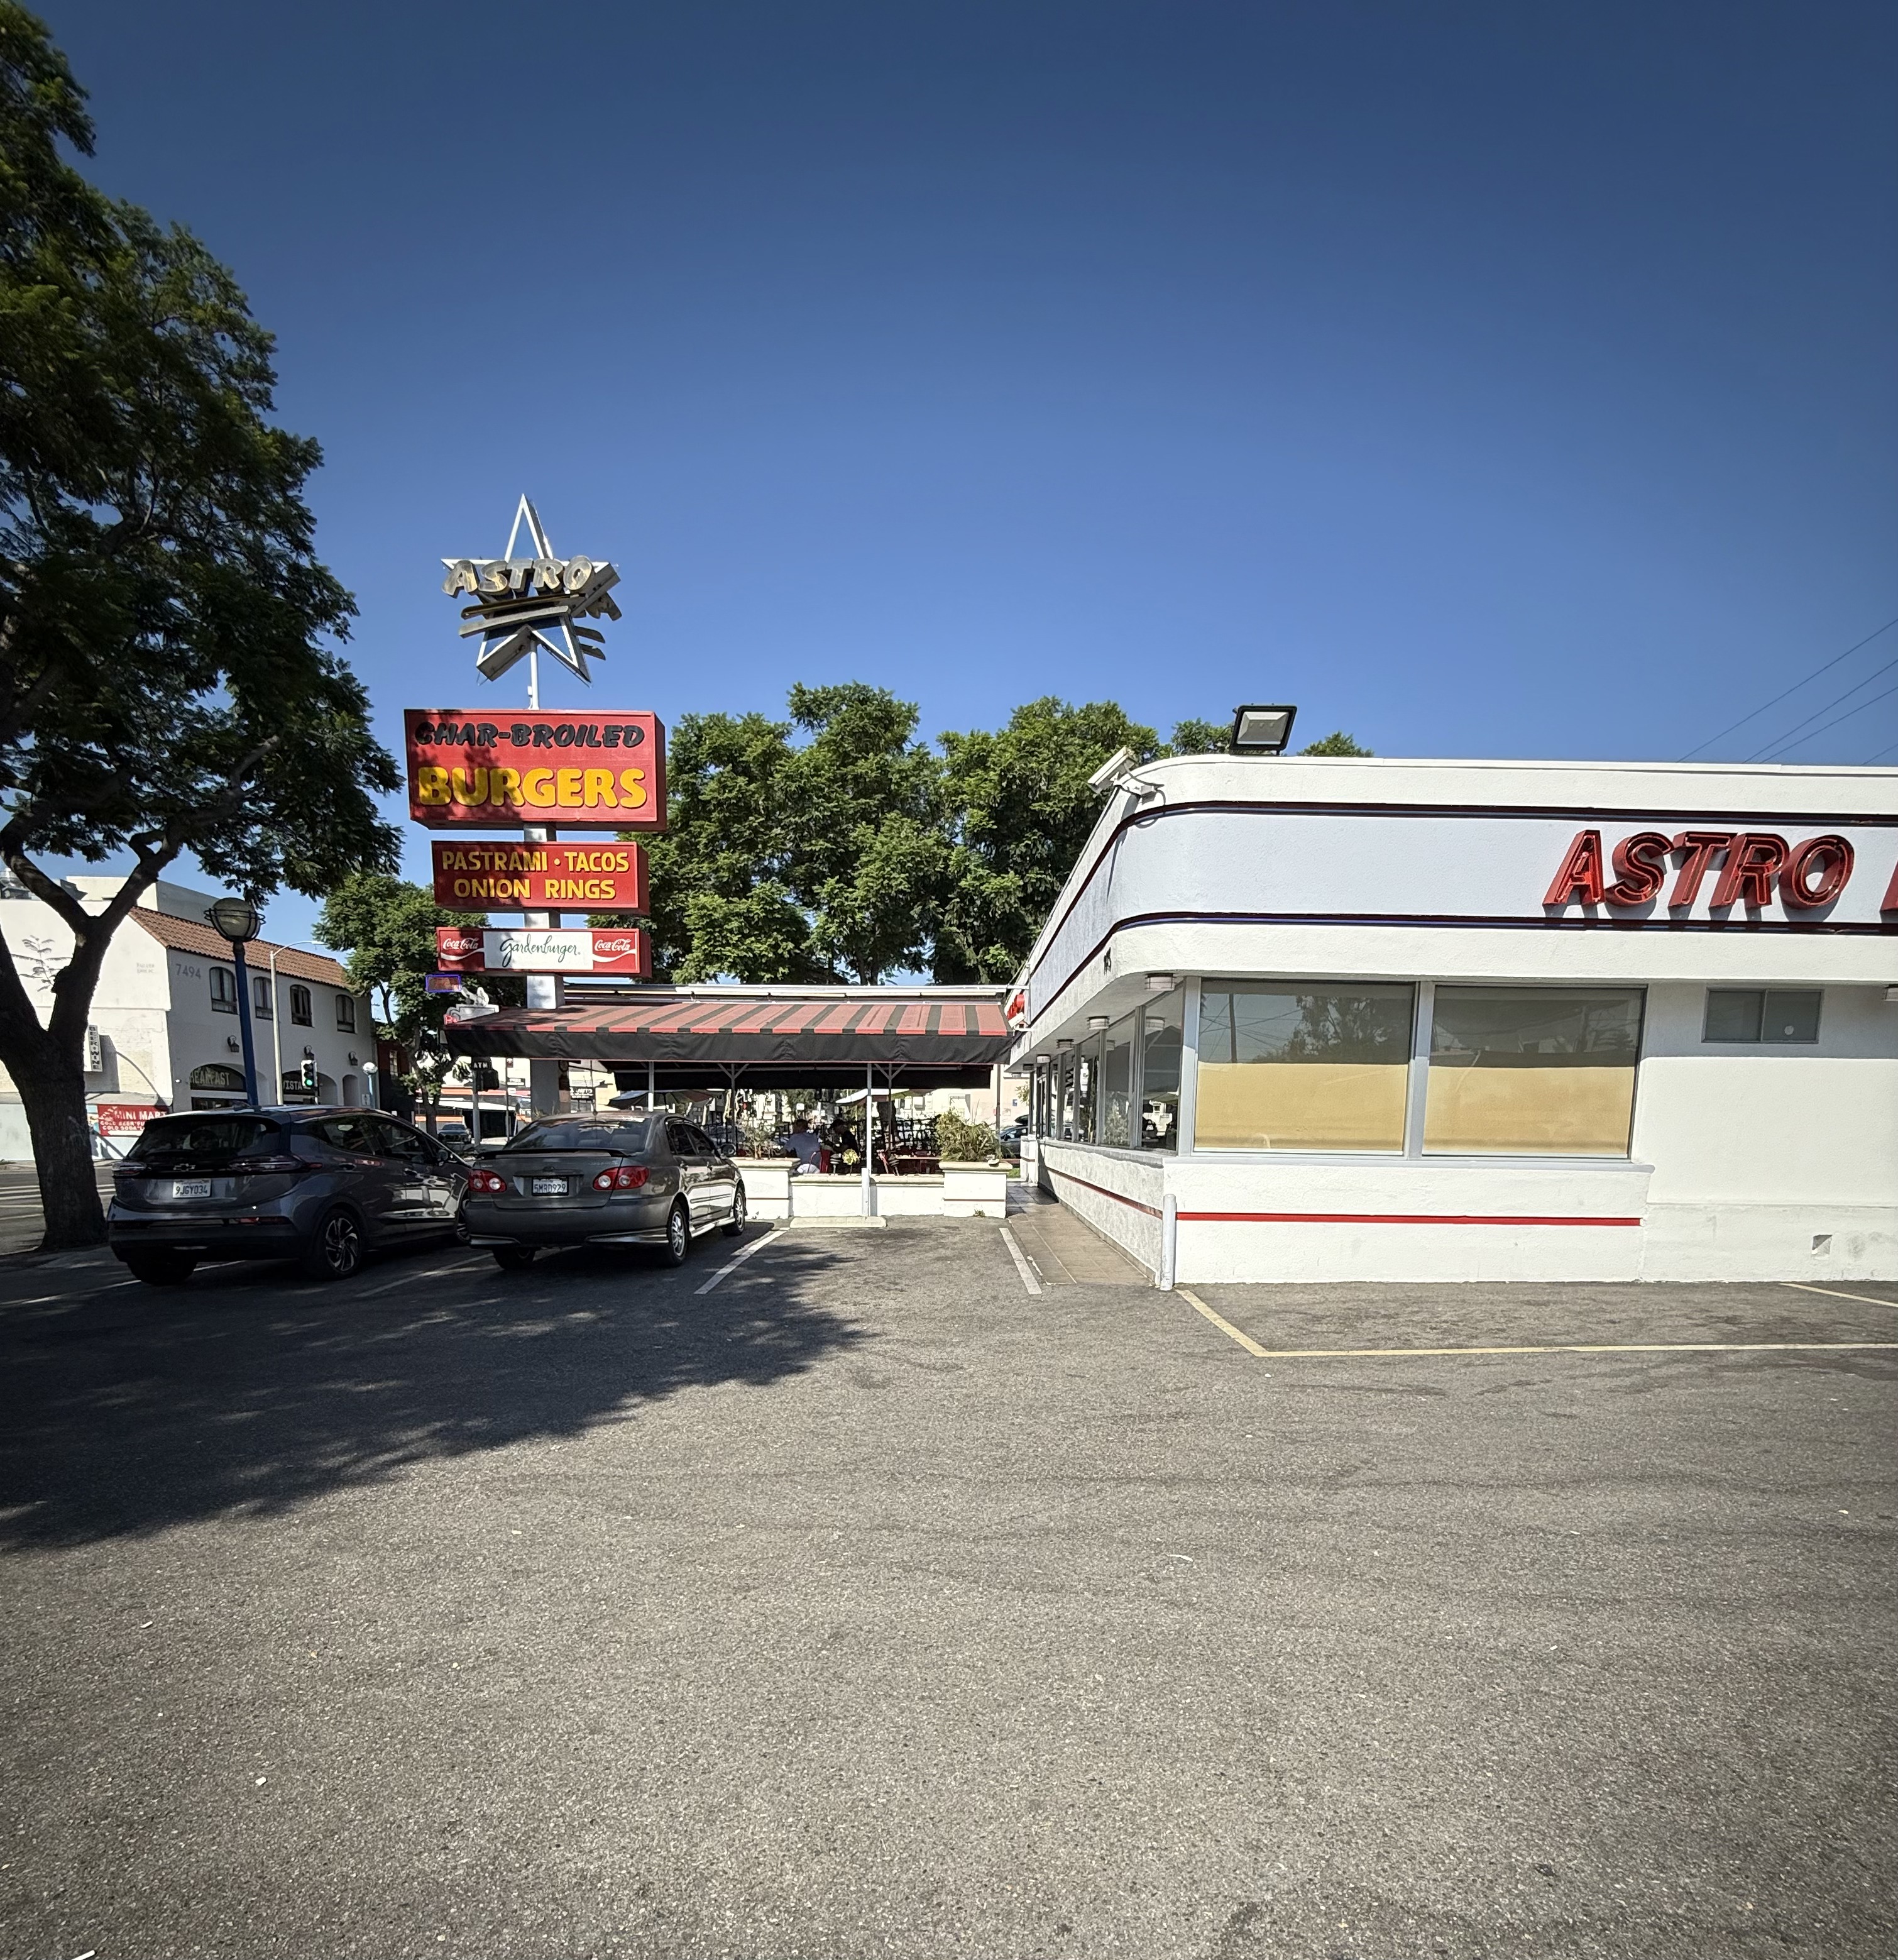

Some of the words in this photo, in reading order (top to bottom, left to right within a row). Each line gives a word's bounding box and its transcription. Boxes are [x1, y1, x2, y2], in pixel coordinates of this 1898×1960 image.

[442, 556, 595, 598] ASTRO
[415, 722, 645, 748] CHAR-BROILED
[418, 766, 647, 808] BURGERS
[442, 851, 547, 872] PASTRAMI
[564, 852, 629, 872] TACOS
[1542, 830, 1855, 909] ASTRO
[454, 879, 531, 898] ONION
[545, 879, 616, 900] RINGS
[175, 964, 201, 979] 7494
[114, 1111, 136, 1120] MINI
